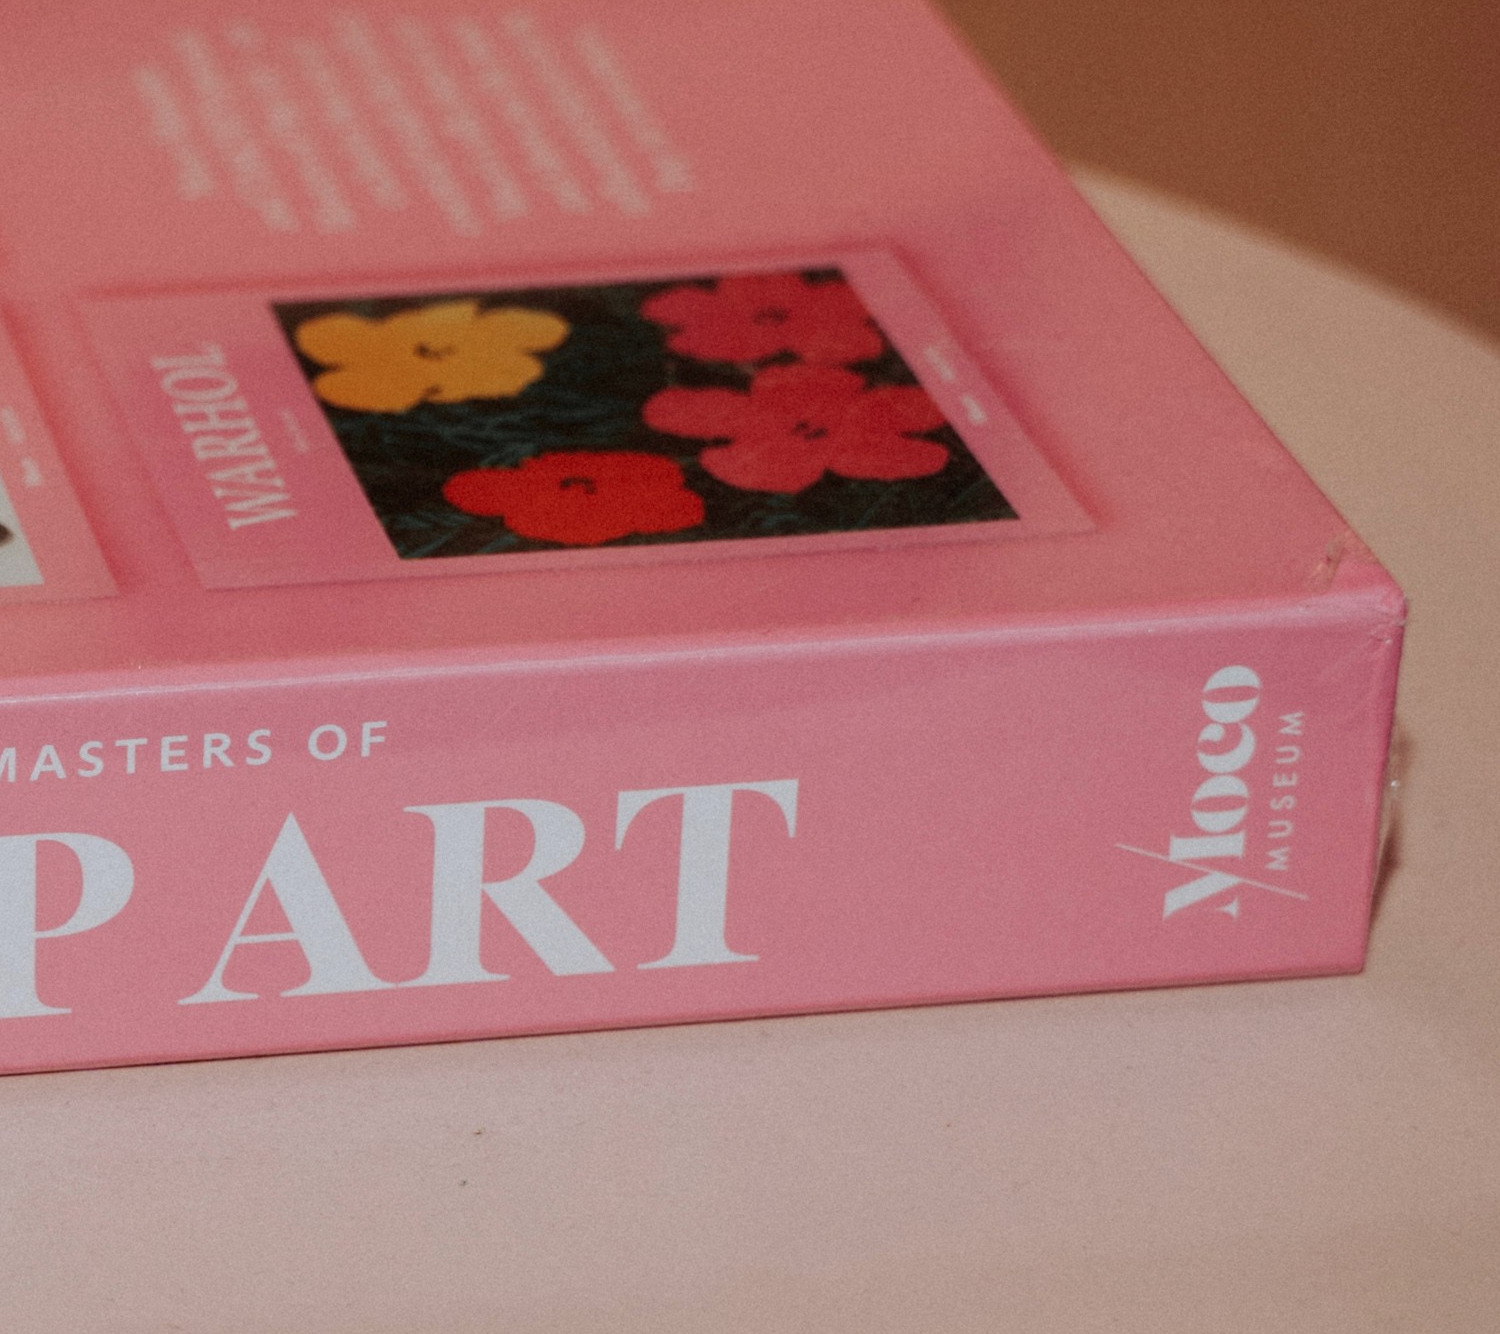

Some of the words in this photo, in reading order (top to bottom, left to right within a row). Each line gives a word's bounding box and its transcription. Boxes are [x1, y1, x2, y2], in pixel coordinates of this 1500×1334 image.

[152, 343, 298, 531] WARHOL
[307, 720, 389, 763] OF
[1163, 664, 1261, 920] Moco
[1266, 709, 1303, 872] MUSEUM
[176, 777, 800, 1007] ART
